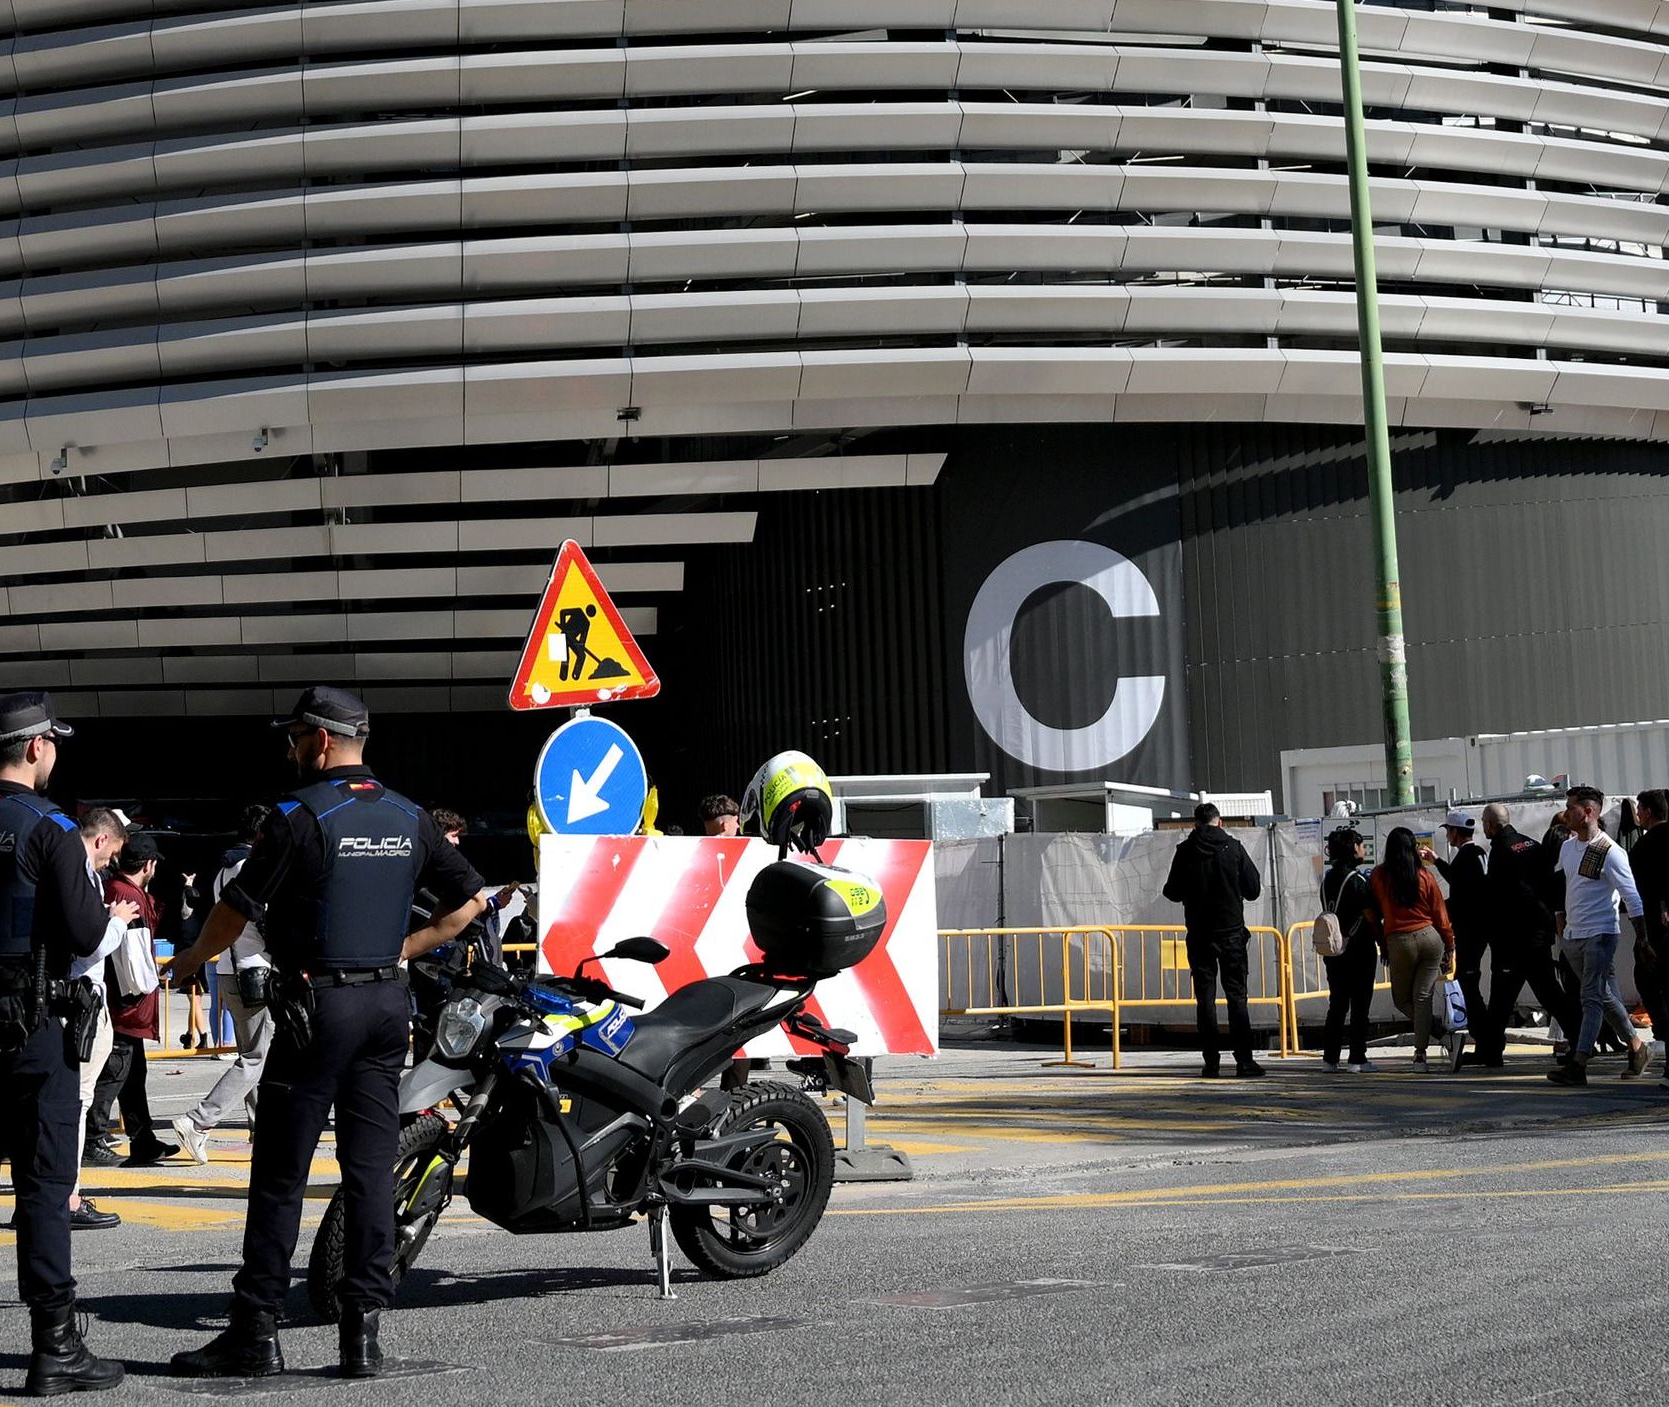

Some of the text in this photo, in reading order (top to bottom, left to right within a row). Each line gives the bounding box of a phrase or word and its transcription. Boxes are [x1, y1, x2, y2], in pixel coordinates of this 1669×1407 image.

[963, 539, 1166, 772] C
[338, 835, 413, 850] POLICÍA
[375, 849, 411, 857] MADRID
